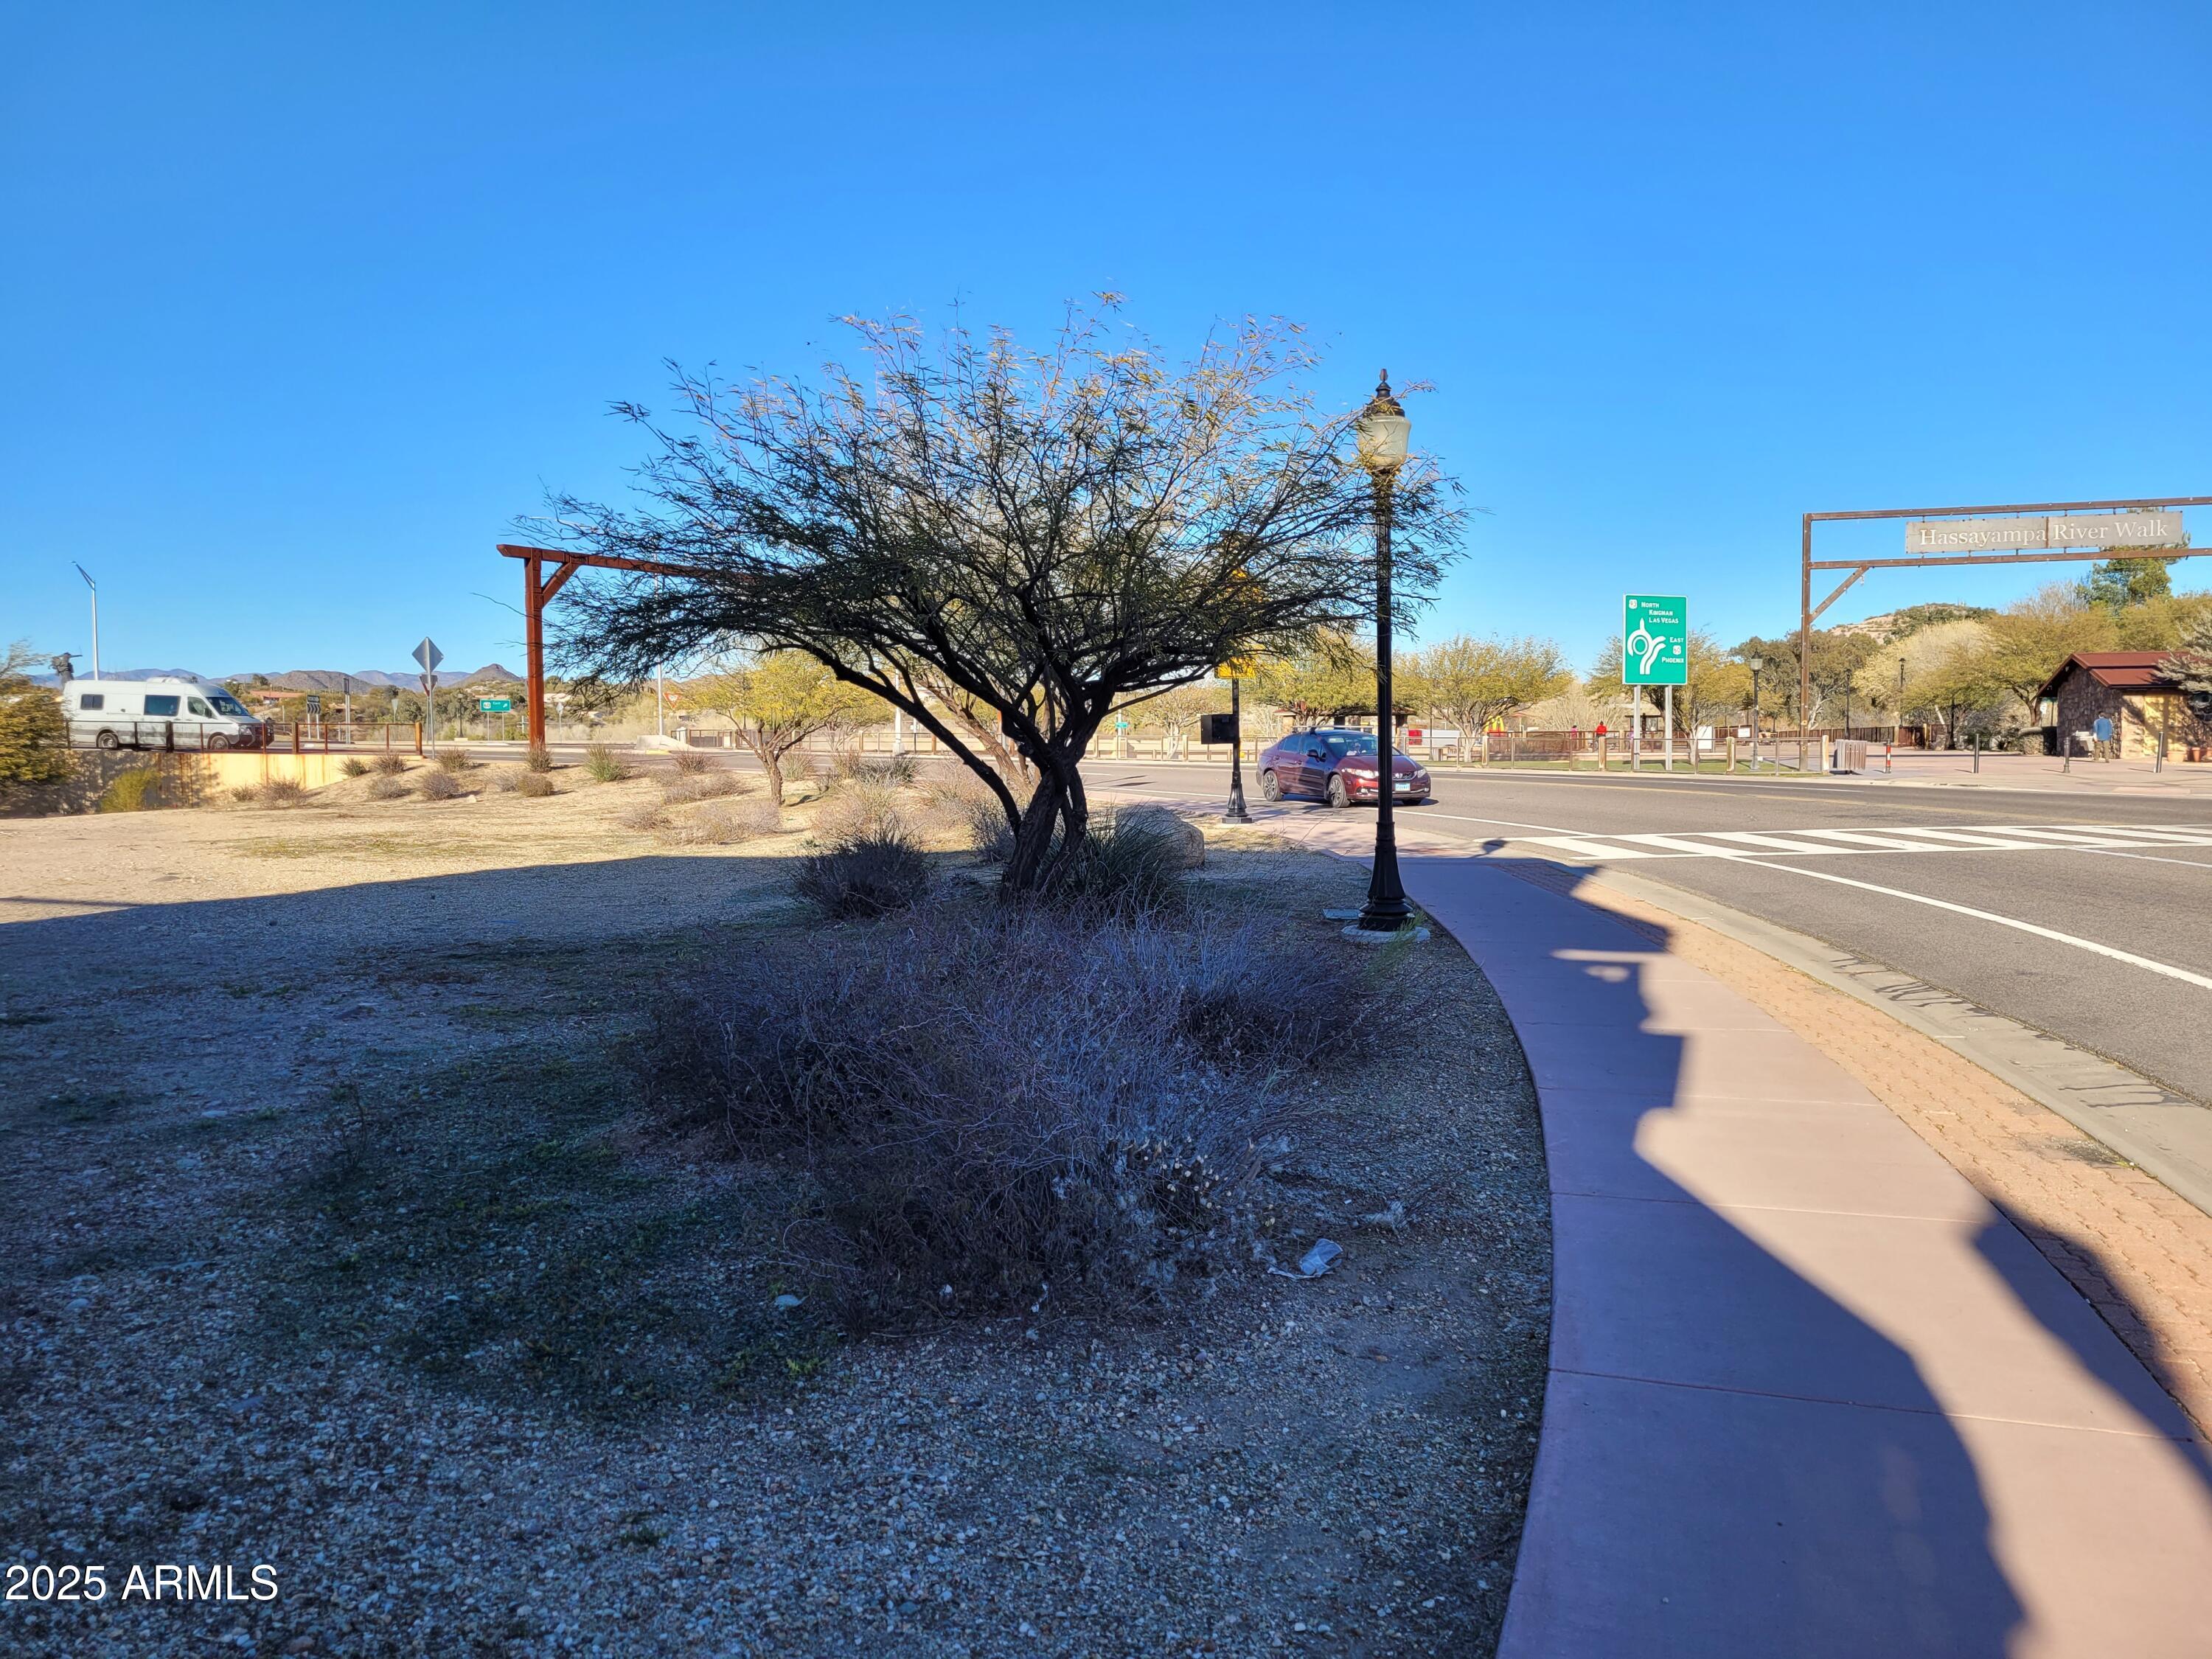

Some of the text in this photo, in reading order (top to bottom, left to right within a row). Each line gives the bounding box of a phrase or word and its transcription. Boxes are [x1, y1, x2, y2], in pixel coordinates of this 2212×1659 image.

[1920, 519, 2168, 547] Hassayampa River Walk
